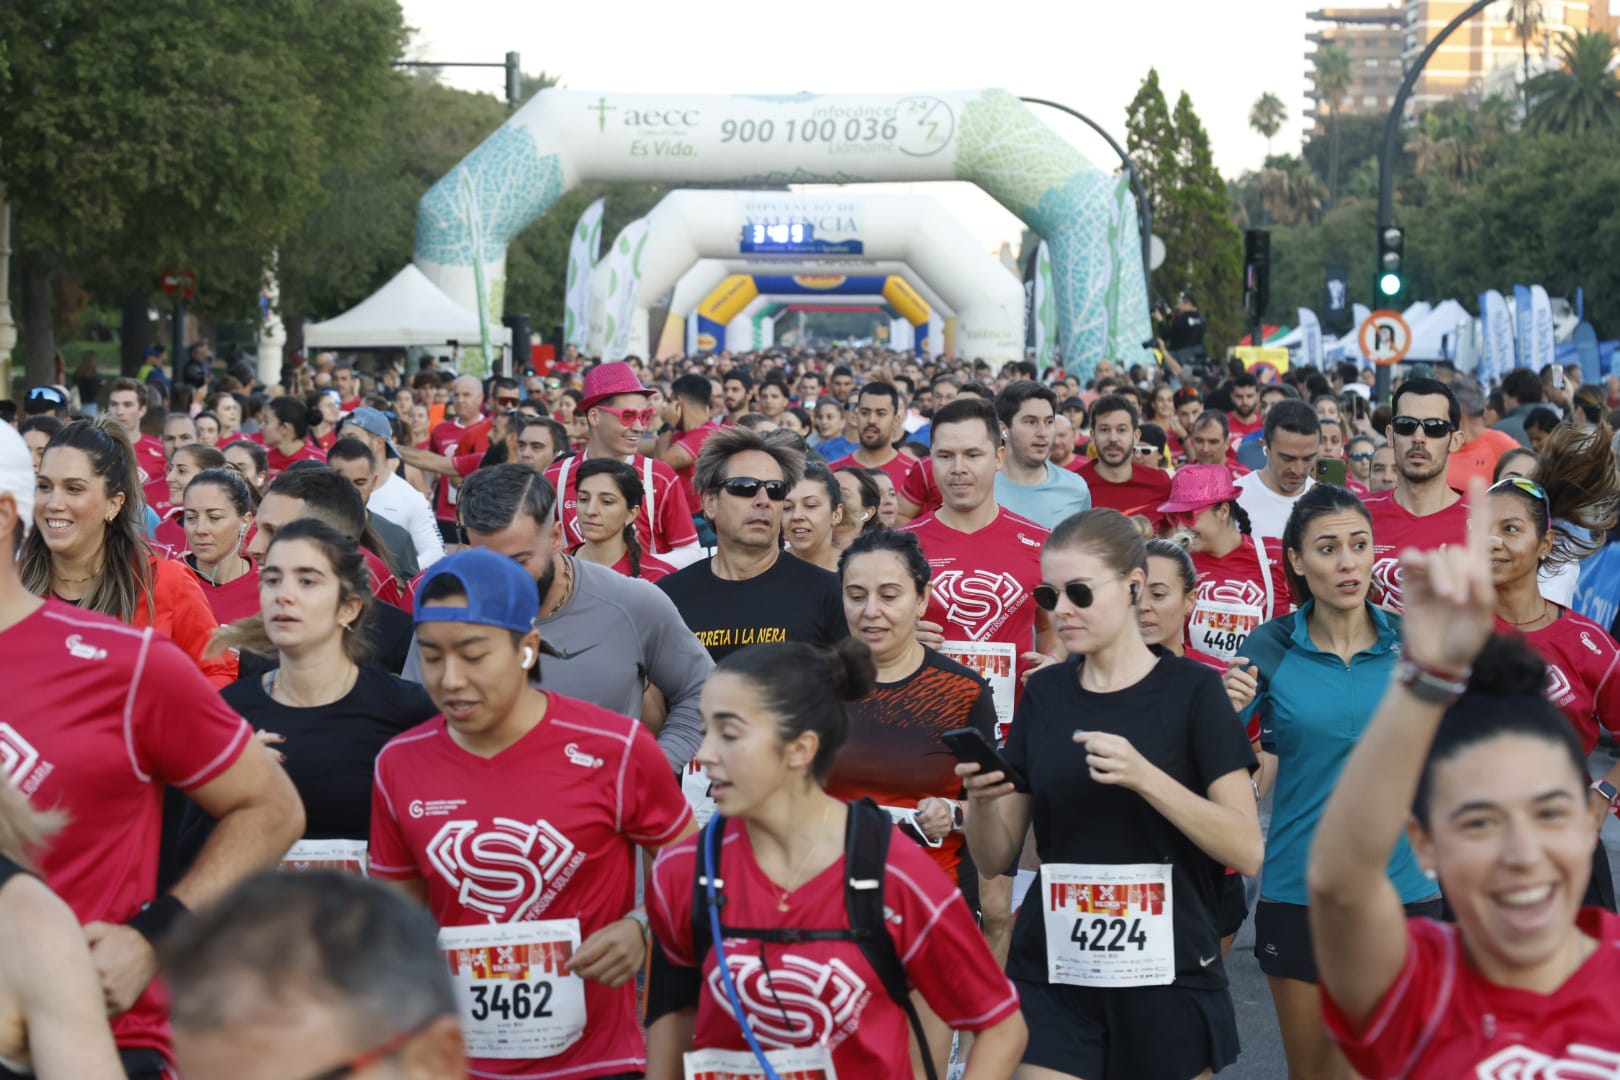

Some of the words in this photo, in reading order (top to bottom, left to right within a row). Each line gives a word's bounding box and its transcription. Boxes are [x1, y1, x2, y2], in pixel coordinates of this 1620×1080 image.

[624, 109, 701, 127] aecc
[720, 119, 775, 143] 900
[786, 118, 836, 143] 100
[844, 118, 898, 142] 036
[631, 140, 649, 157] Es
[654, 140, 698, 158] Vida.
[693, 628, 732, 648] ERRETA
[741, 627, 755, 645] LA
[756, 627, 787, 644] NERA
[1203, 630, 1247, 651] 4480
[1071, 918, 1147, 952] 4224
[469, 980, 553, 1021] 3462
